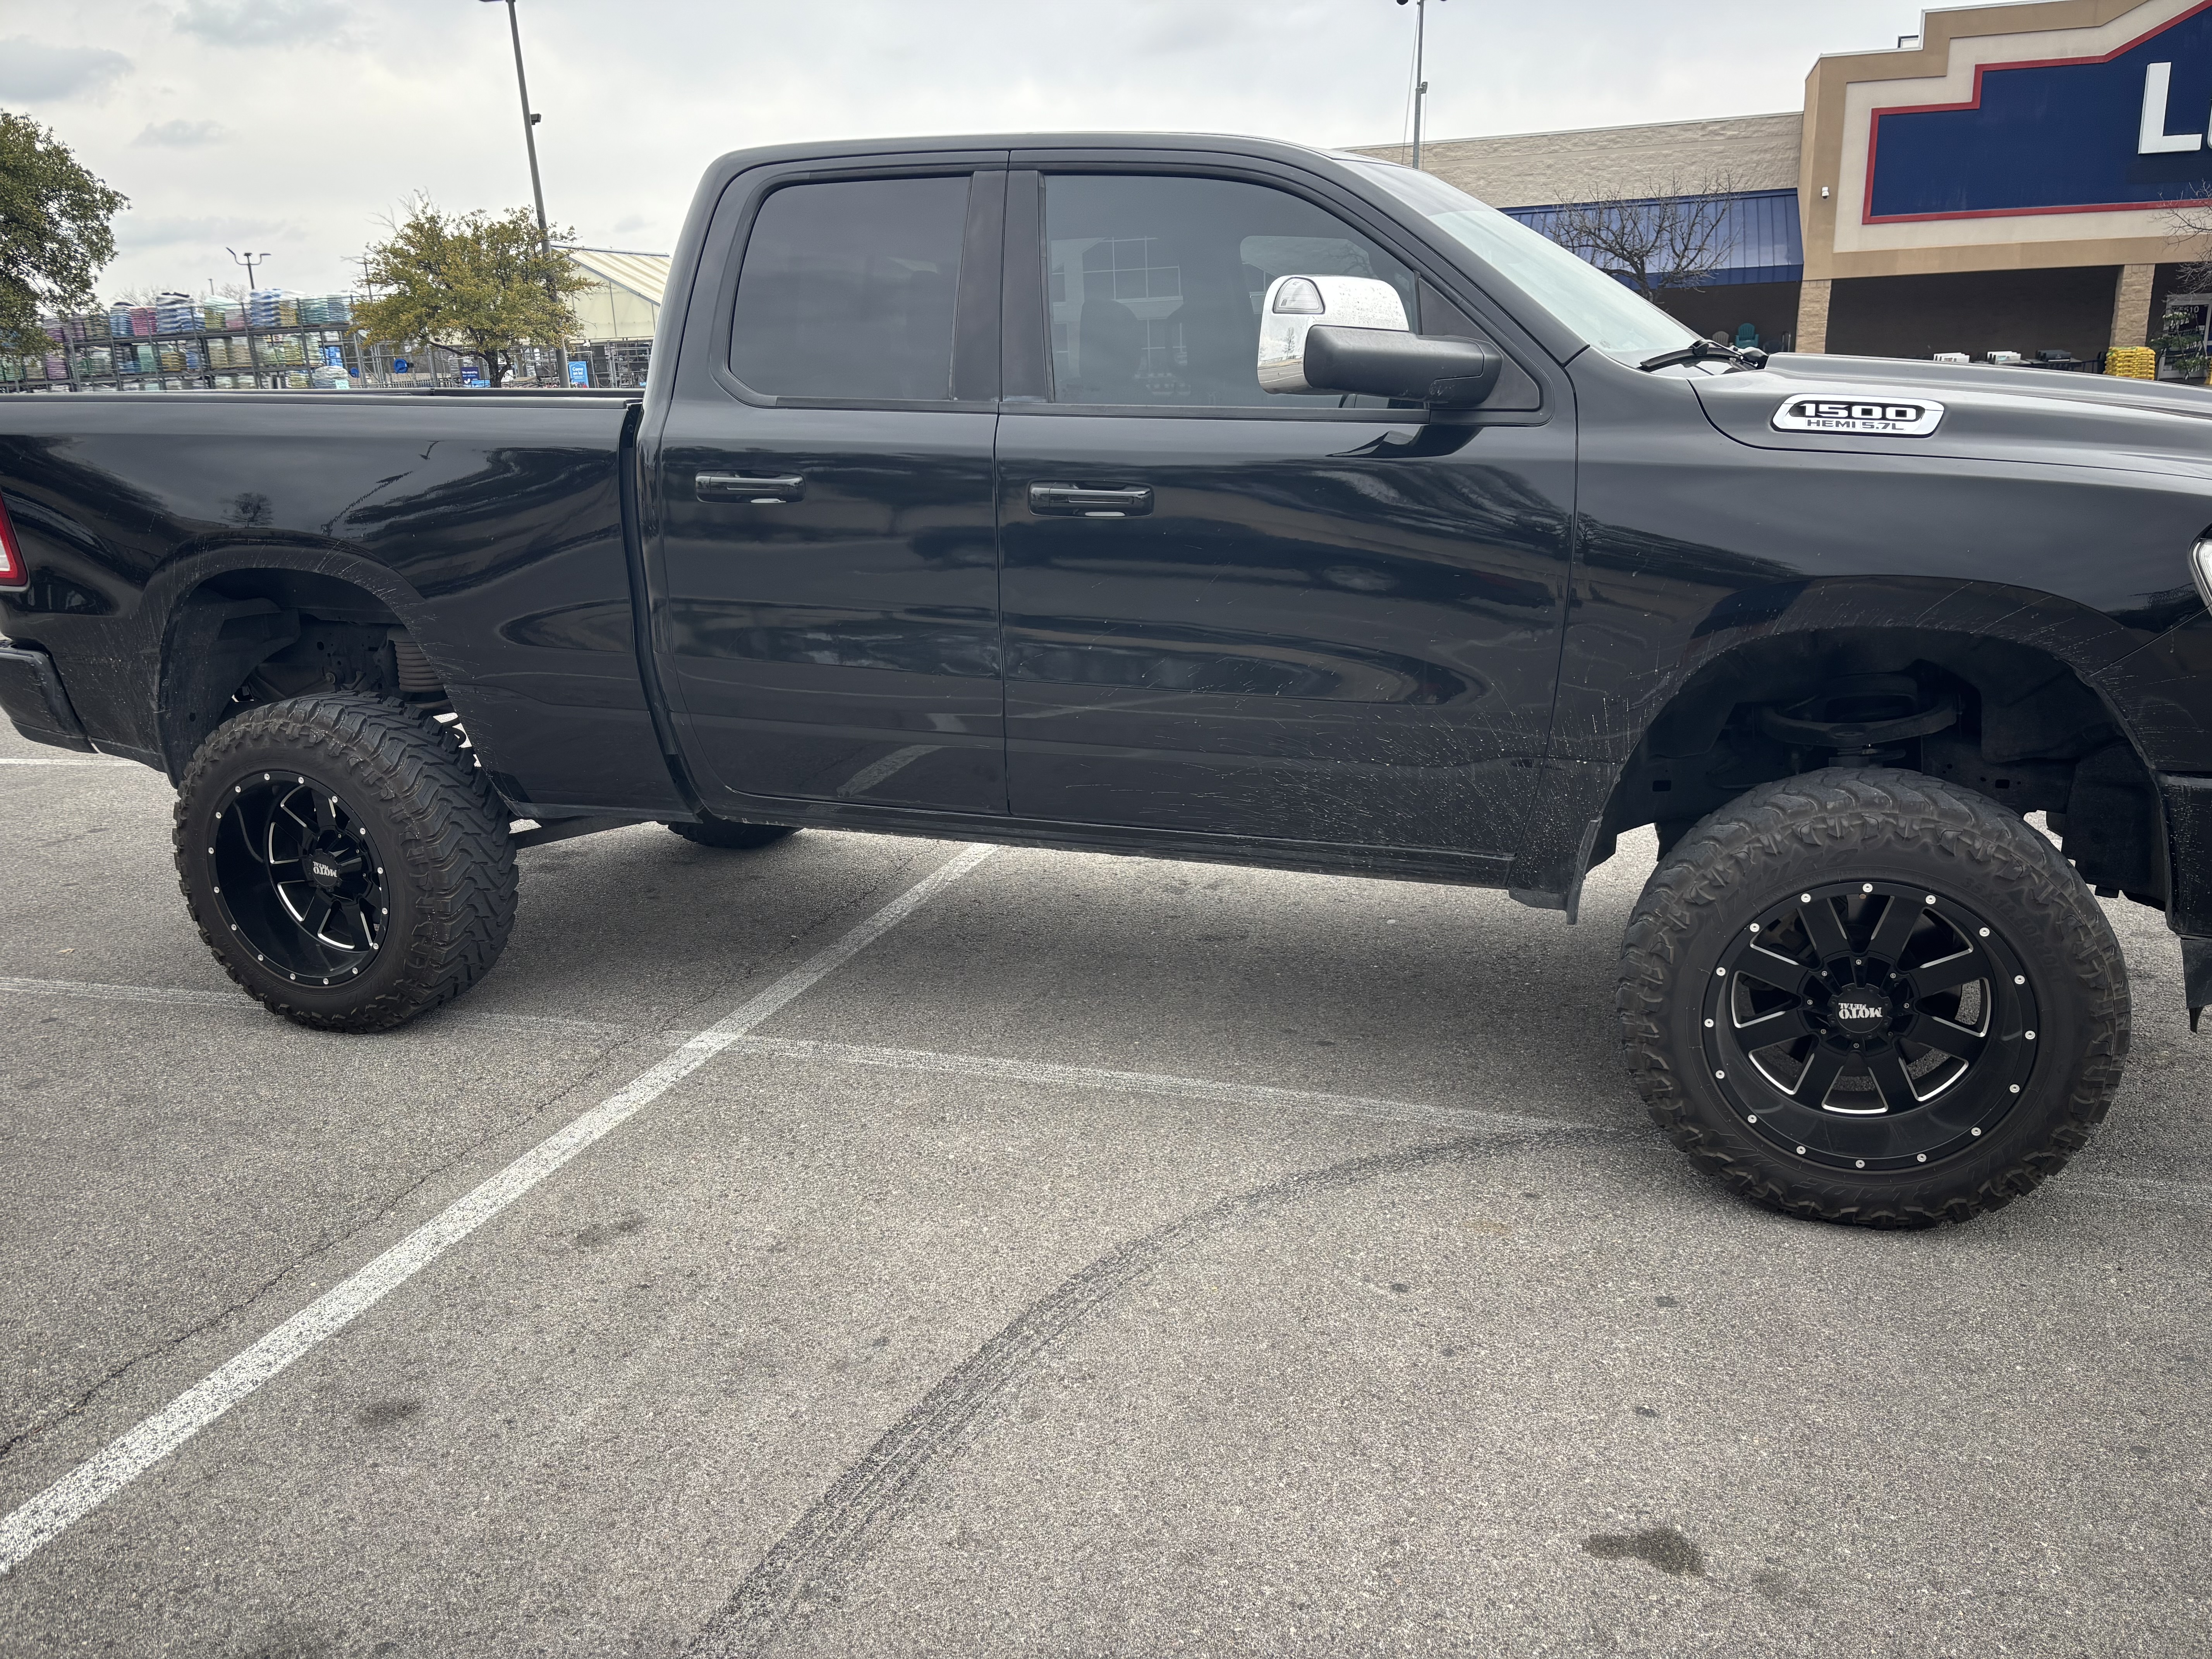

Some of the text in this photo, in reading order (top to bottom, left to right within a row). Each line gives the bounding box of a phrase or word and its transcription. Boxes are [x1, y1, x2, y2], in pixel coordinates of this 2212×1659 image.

[2138, 62, 2212, 155] L
[1799, 403, 1917, 420] 1500
[1807, 419, 1905, 430] HEMI 5.7L
[313, 866, 338, 878] MOTO
[1839, 1007, 1883, 1019] MOTO
